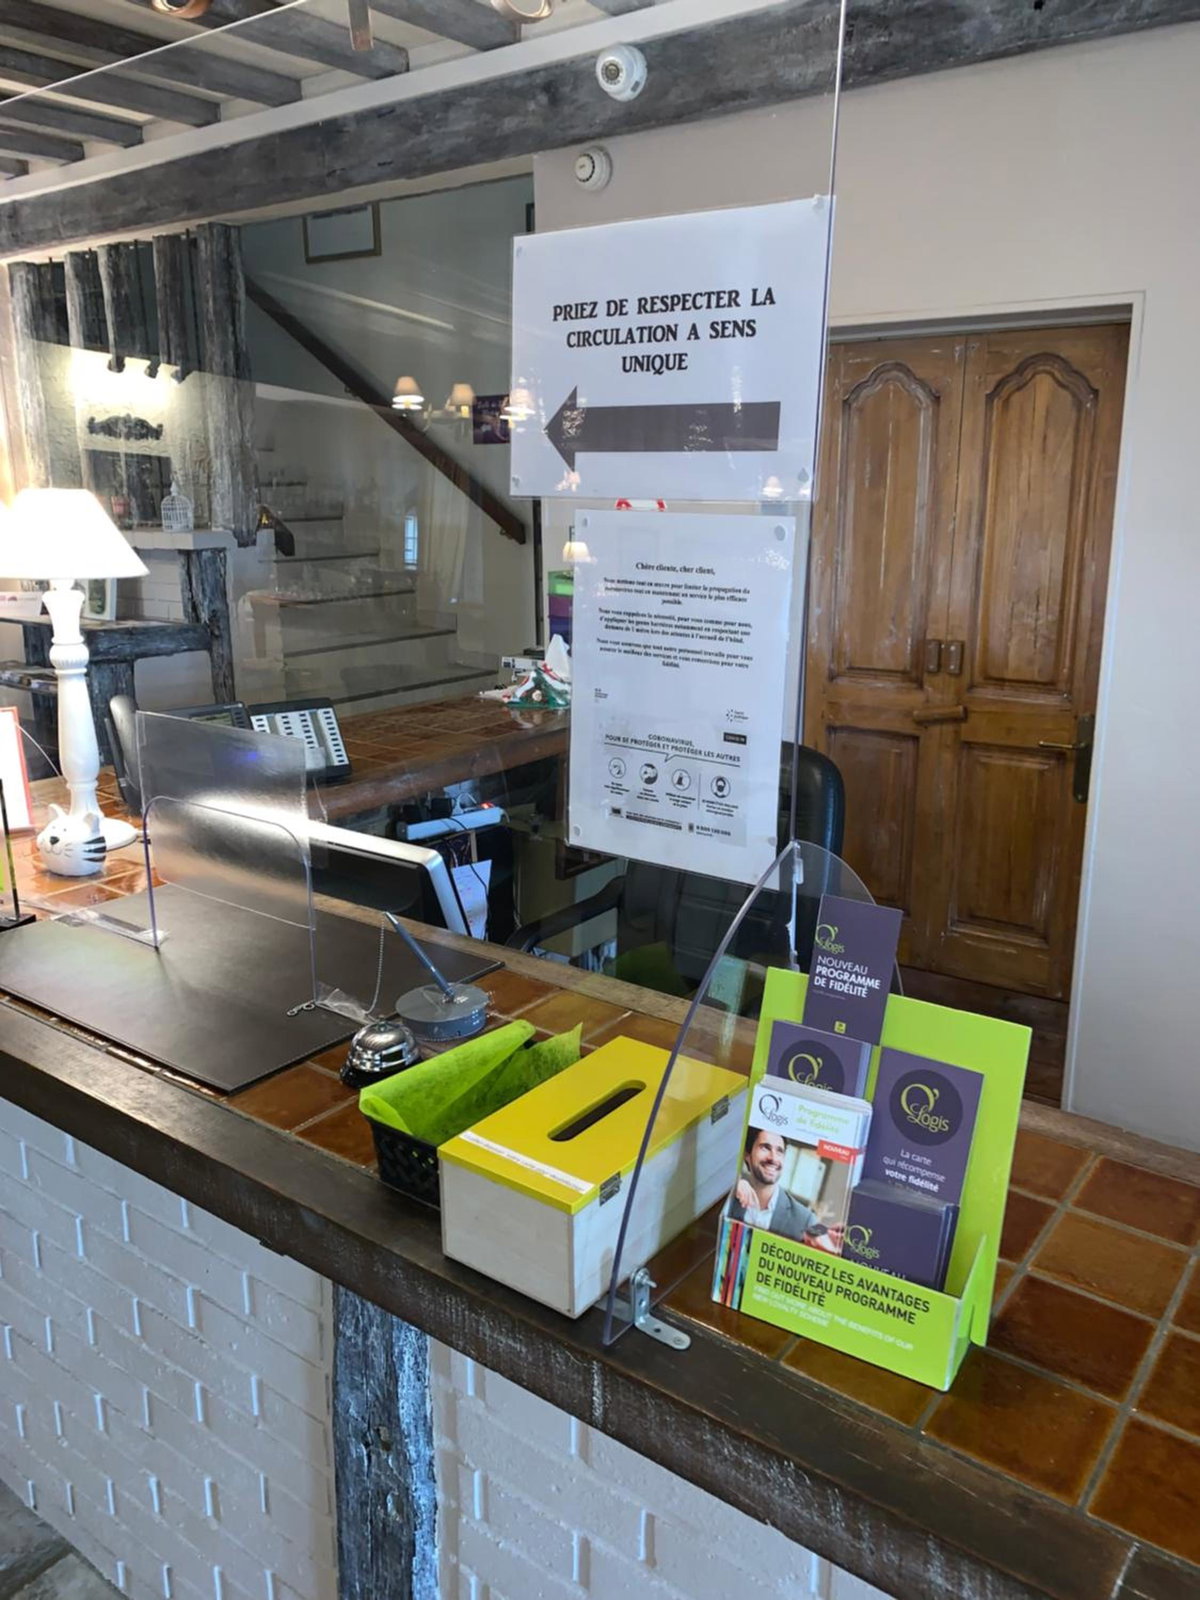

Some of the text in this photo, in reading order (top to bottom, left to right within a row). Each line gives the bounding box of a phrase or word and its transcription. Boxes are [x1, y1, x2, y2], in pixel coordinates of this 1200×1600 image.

[553, 287, 776, 321] PRIEZ DE RESPECTER LA
[566, 319, 757, 348] CIRCULATION A SENS
[621, 353, 688, 375] UNIQUE
[815, 965, 881, 990] PROGRAMME
[817, 955, 868, 975] NOUVEAU
[814, 976, 826, 987] DE
[829, 979, 868, 998] FIDÉLITÉ
[900, 1149, 932, 1166] La carte
[885, 1169, 907, 1181] votre
[908, 1175, 940, 1192] fidélité
[756, 1271, 826, 1307] DE FIDÉLITÉ
[761, 1242, 830, 1277] DÉCOUVREZ
[832, 1267, 854, 1285] LES
[857, 1274, 931, 1313] AVANTAGES
[758, 1257, 776, 1272] DU
[776, 1264, 833, 1293] NOUVEAU
[836, 1285, 917, 1325] PROGRAMME
